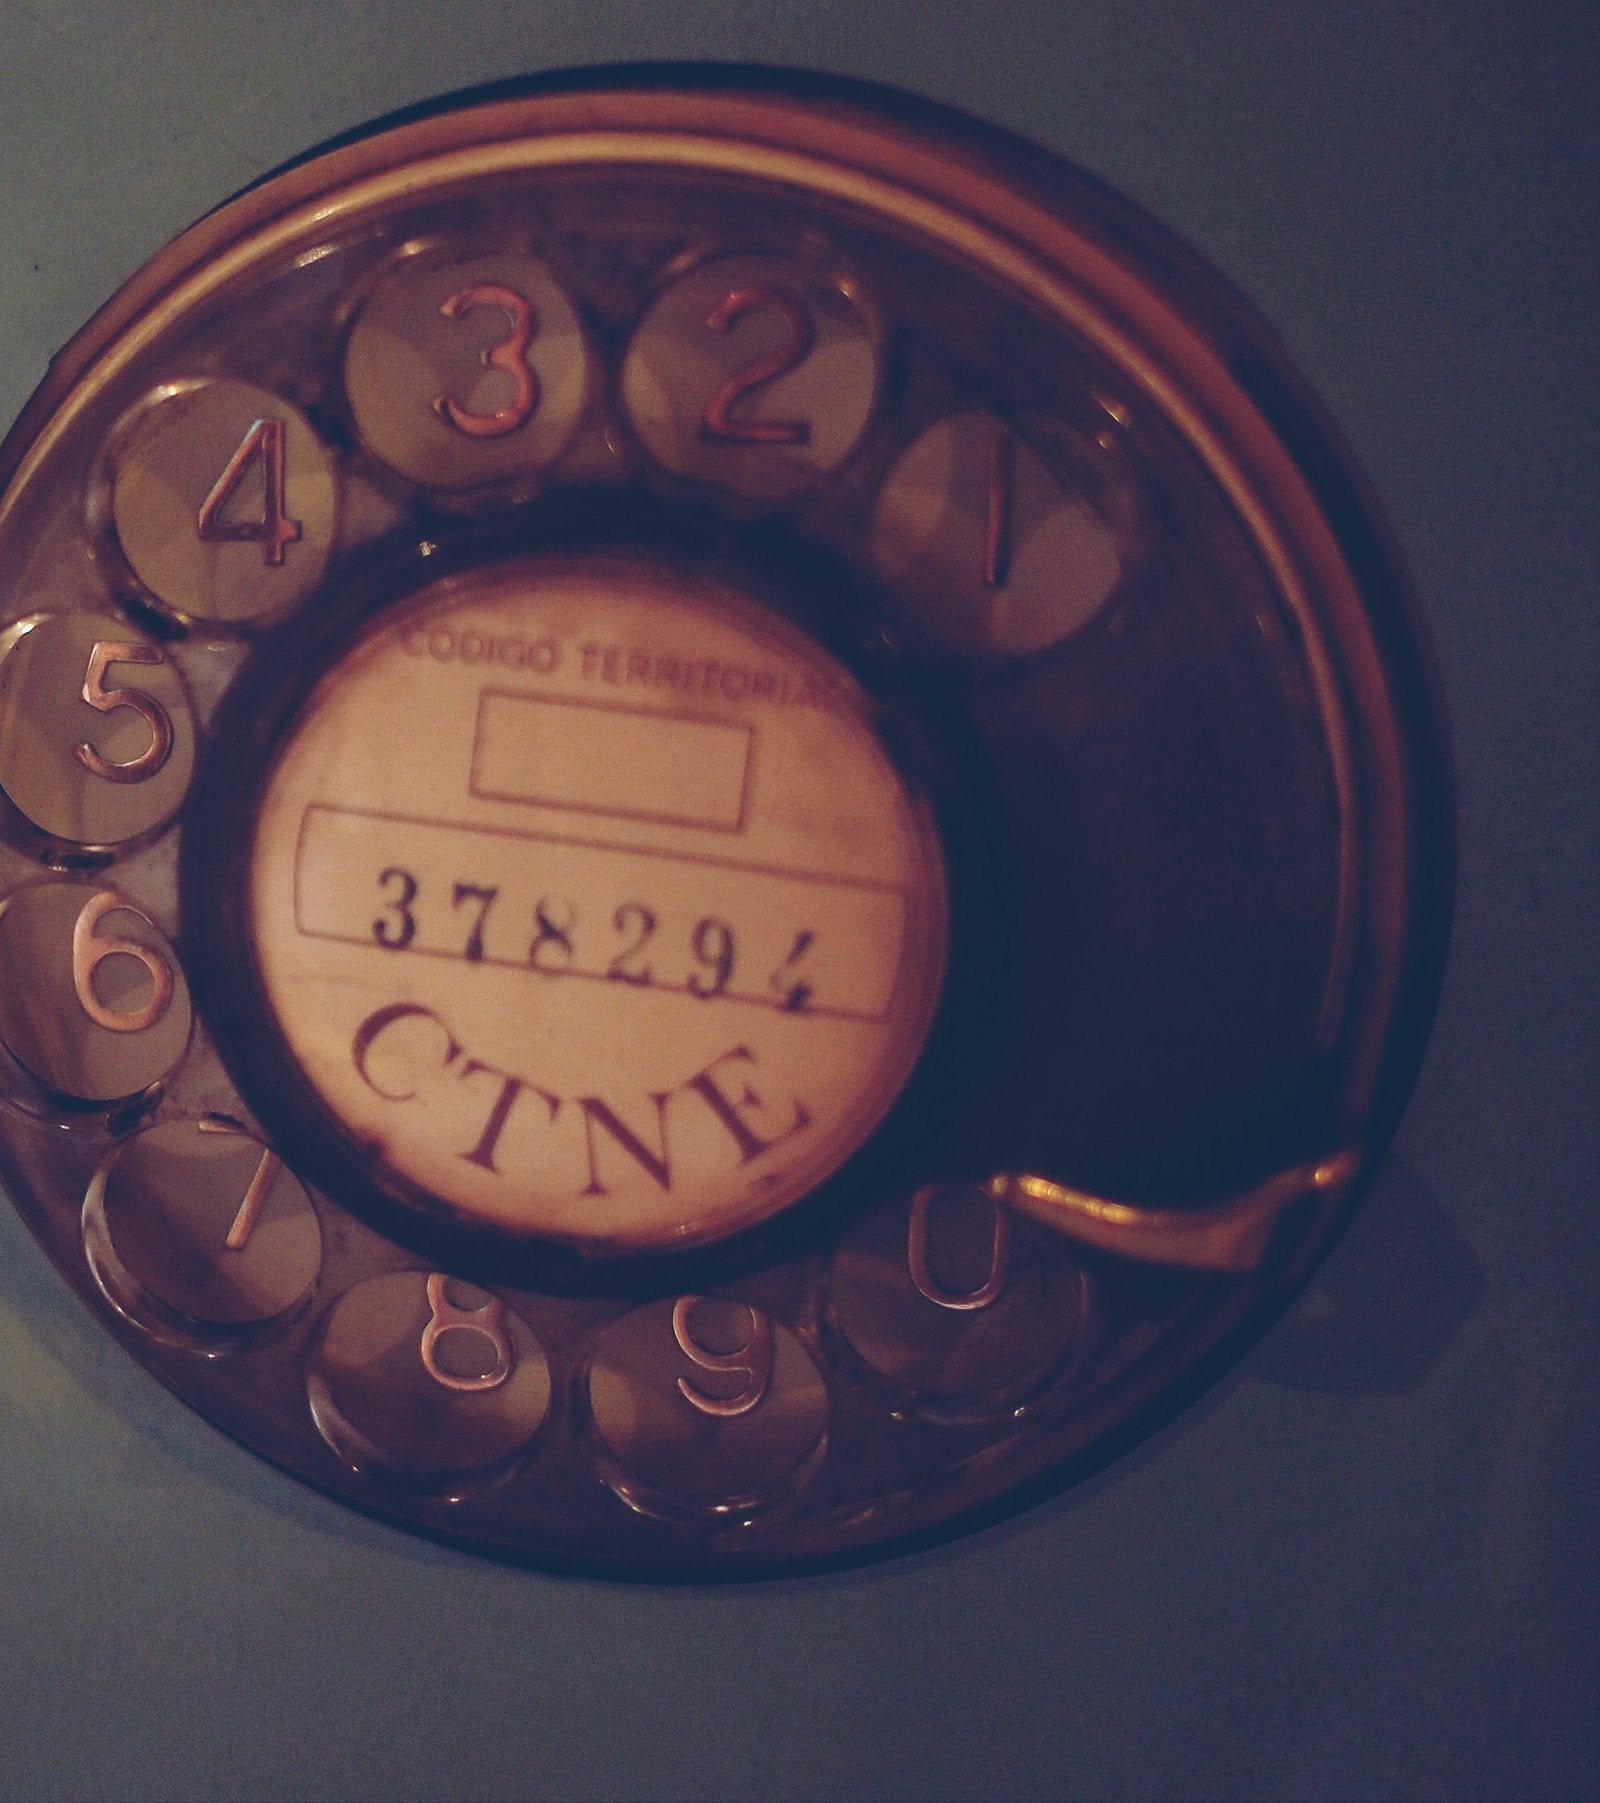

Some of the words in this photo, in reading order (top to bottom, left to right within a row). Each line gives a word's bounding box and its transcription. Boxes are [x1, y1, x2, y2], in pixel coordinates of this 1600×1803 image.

[434, 281, 538, 438] 3
[700, 284, 816, 444] 2
[198, 417, 303, 567] 4
[984, 428, 1015, 590] 1
[72, 640, 175, 785] 5
[398, 622, 561, 675] CODIGO
[72, 890, 174, 1033] 6
[371, 865, 816, 1014] 378294
[350, 1001, 812, 1191] CTNE
[421, 1270, 513, 1391] 8
[672, 1294, 771, 1417] 9
